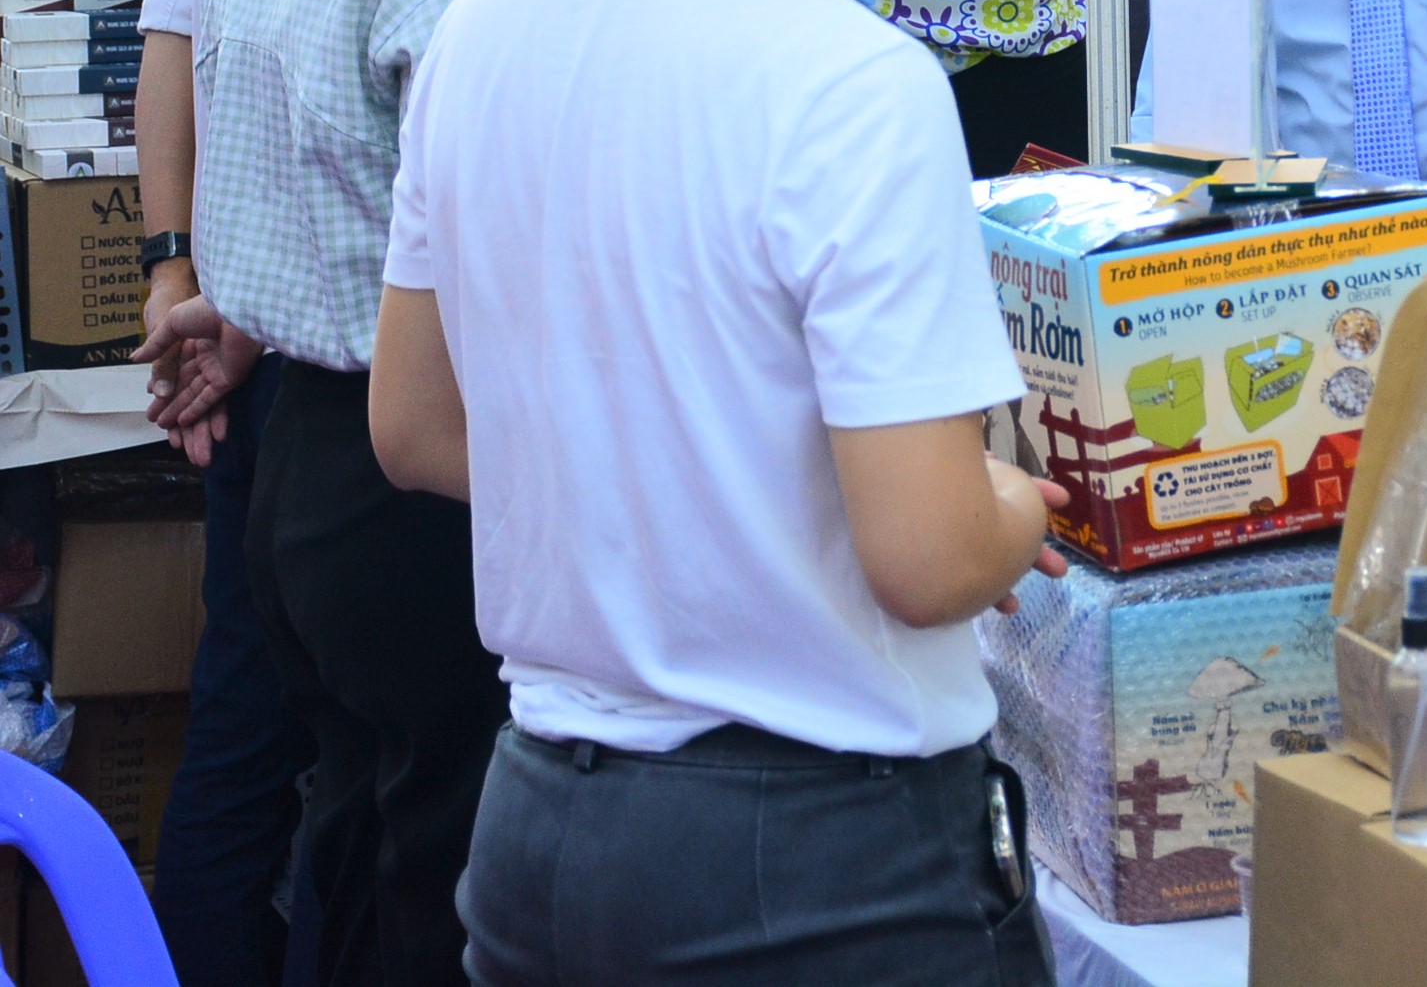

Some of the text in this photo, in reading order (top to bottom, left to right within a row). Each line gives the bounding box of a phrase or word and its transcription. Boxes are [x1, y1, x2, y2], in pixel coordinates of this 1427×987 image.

[1110, 265, 1137, 283] Trở
[1140, 257, 1188, 277] thành
[1192, 251, 1233, 268] nông
[1236, 243, 1267, 261] dân
[1271, 238, 1305, 255] thực
[1308, 232, 1334, 249] thụ
[1338, 226, 1370, 241] như
[1372, 215, 1397, 236] thế
[991, 241, 1032, 303] nông
[1184, 244, 1372, 287] How to become a Mushroom Farmer?
[1344, 269, 1391, 289] QUAN
[1394, 263, 1423, 280] SÁT
[1239, 287, 1269, 308] LẮP
[1275, 284, 1307, 303] ĐẶT
[1347, 284, 1393, 303] OBSERVE
[1138, 307, 1165, 326] MỞ
[1170, 303, 1205, 320] HỘP
[1241, 305, 1277, 323] SET UP
[1030, 301, 1085, 367] Rơm
[1139, 326, 1168, 341] OPEN
[84, 349, 107, 362] AN
[1184, 487, 1203, 497] CHO
